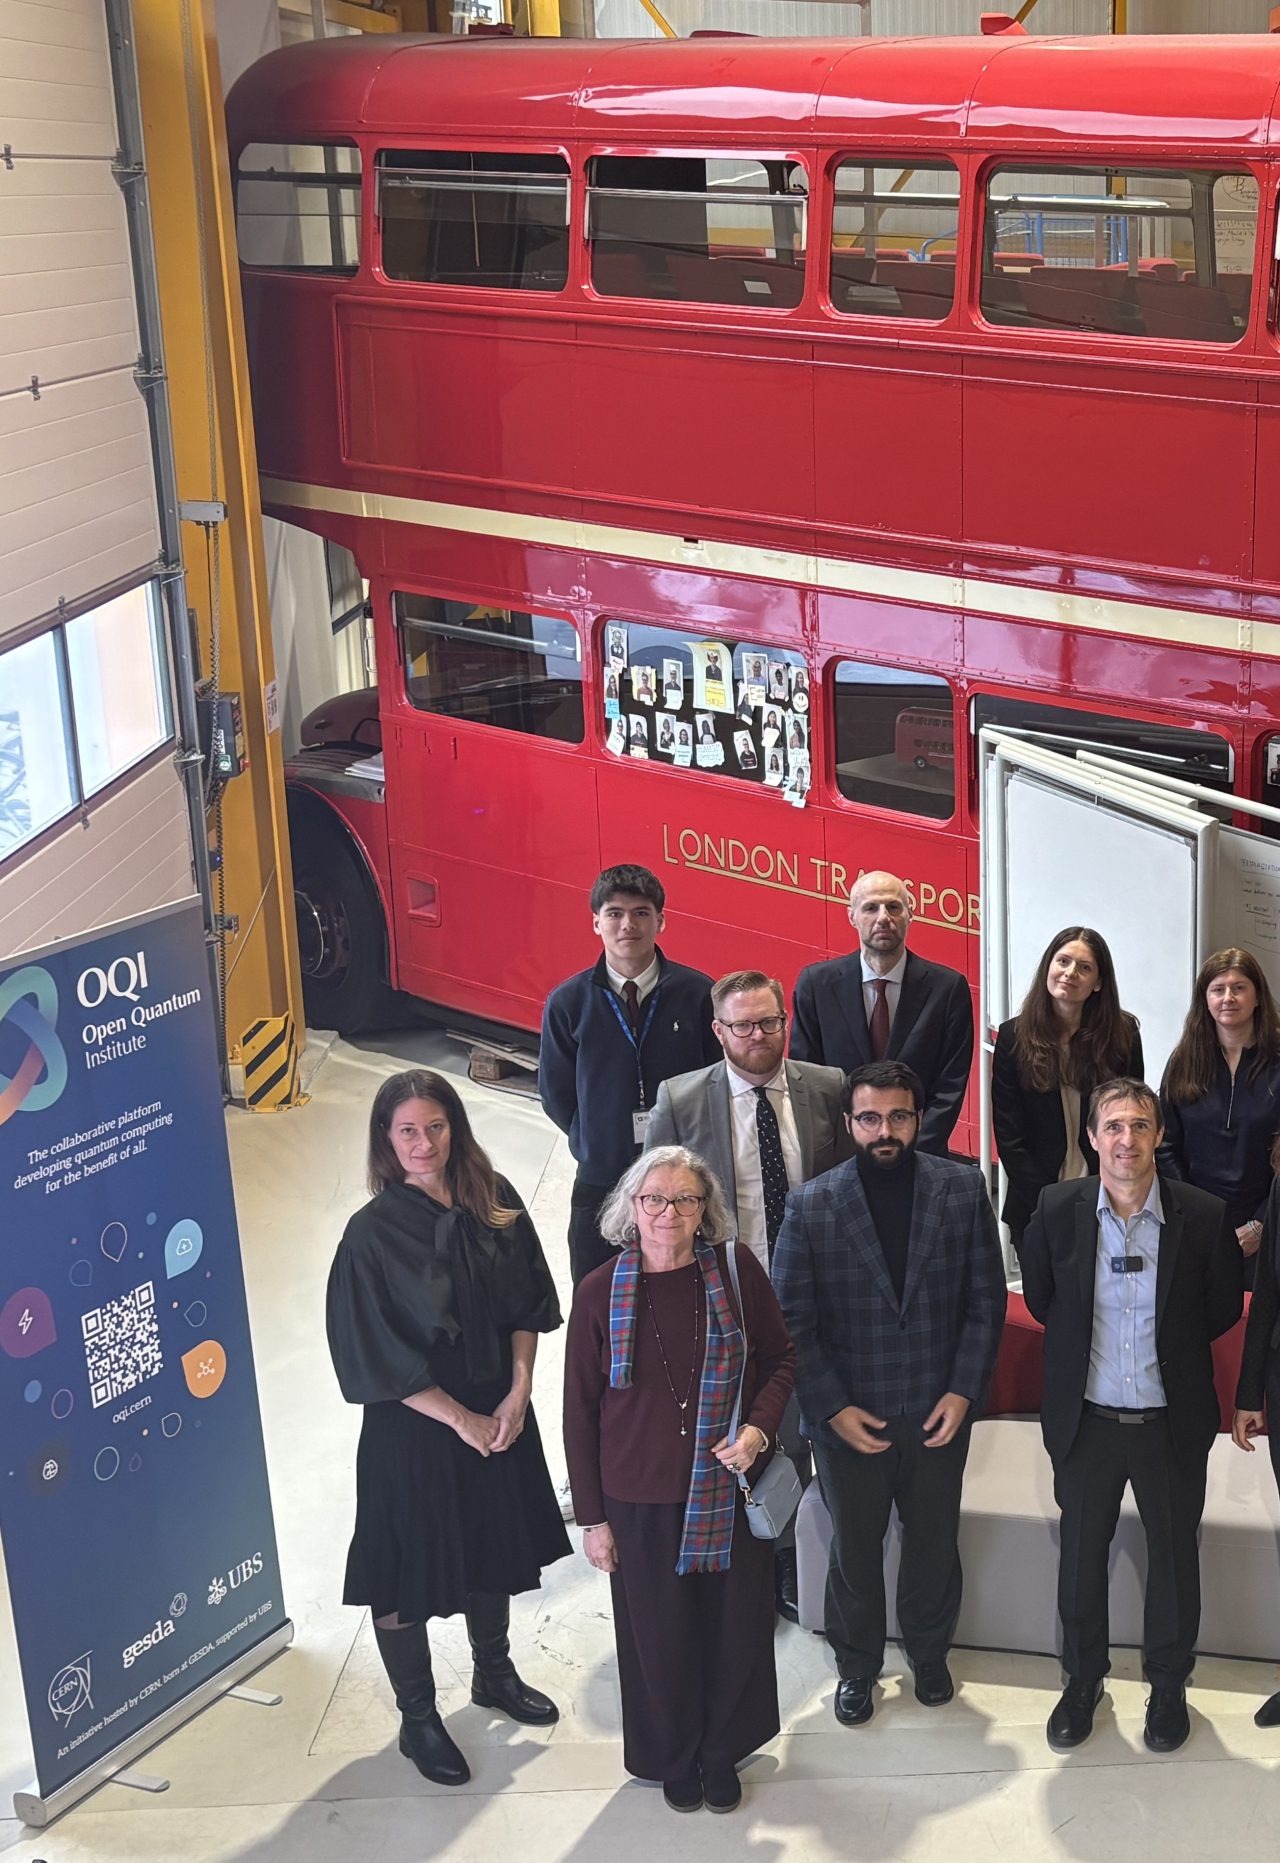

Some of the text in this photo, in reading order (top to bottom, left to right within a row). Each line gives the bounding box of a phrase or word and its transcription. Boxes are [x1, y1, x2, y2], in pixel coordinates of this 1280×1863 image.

[662, 824, 980, 927] LONDON TRSPOR
[77, 951, 149, 1008] OQI
[82, 988, 201, 1045] Open Quantum
[85, 1033, 147, 1069] Institute
[13, 1112, 174, 1189] developing quantum computing
[27, 1101, 162, 1165] The collaborative platform
[44, 1138, 148, 1194] for the benefit of all.
[112, 1395, 152, 1424] oqi.cern
[228, 1552, 264, 1590] UBS
[122, 1618, 176, 1669] gesda
[51, 1676, 79, 1702] CERN
[57, 1745, 69, 1760] An
[69, 1722, 103, 1750] initiative
[103, 1703, 128, 1727] hosted
[128, 1696, 139, 1709] by
[162, 1668, 181, 1684] born
[181, 1661, 189, 1671] at
[215, 1618, 249, 1647] supported
[248, 1611, 258, 1622] by
[257, 1601, 273, 1616] UBS
